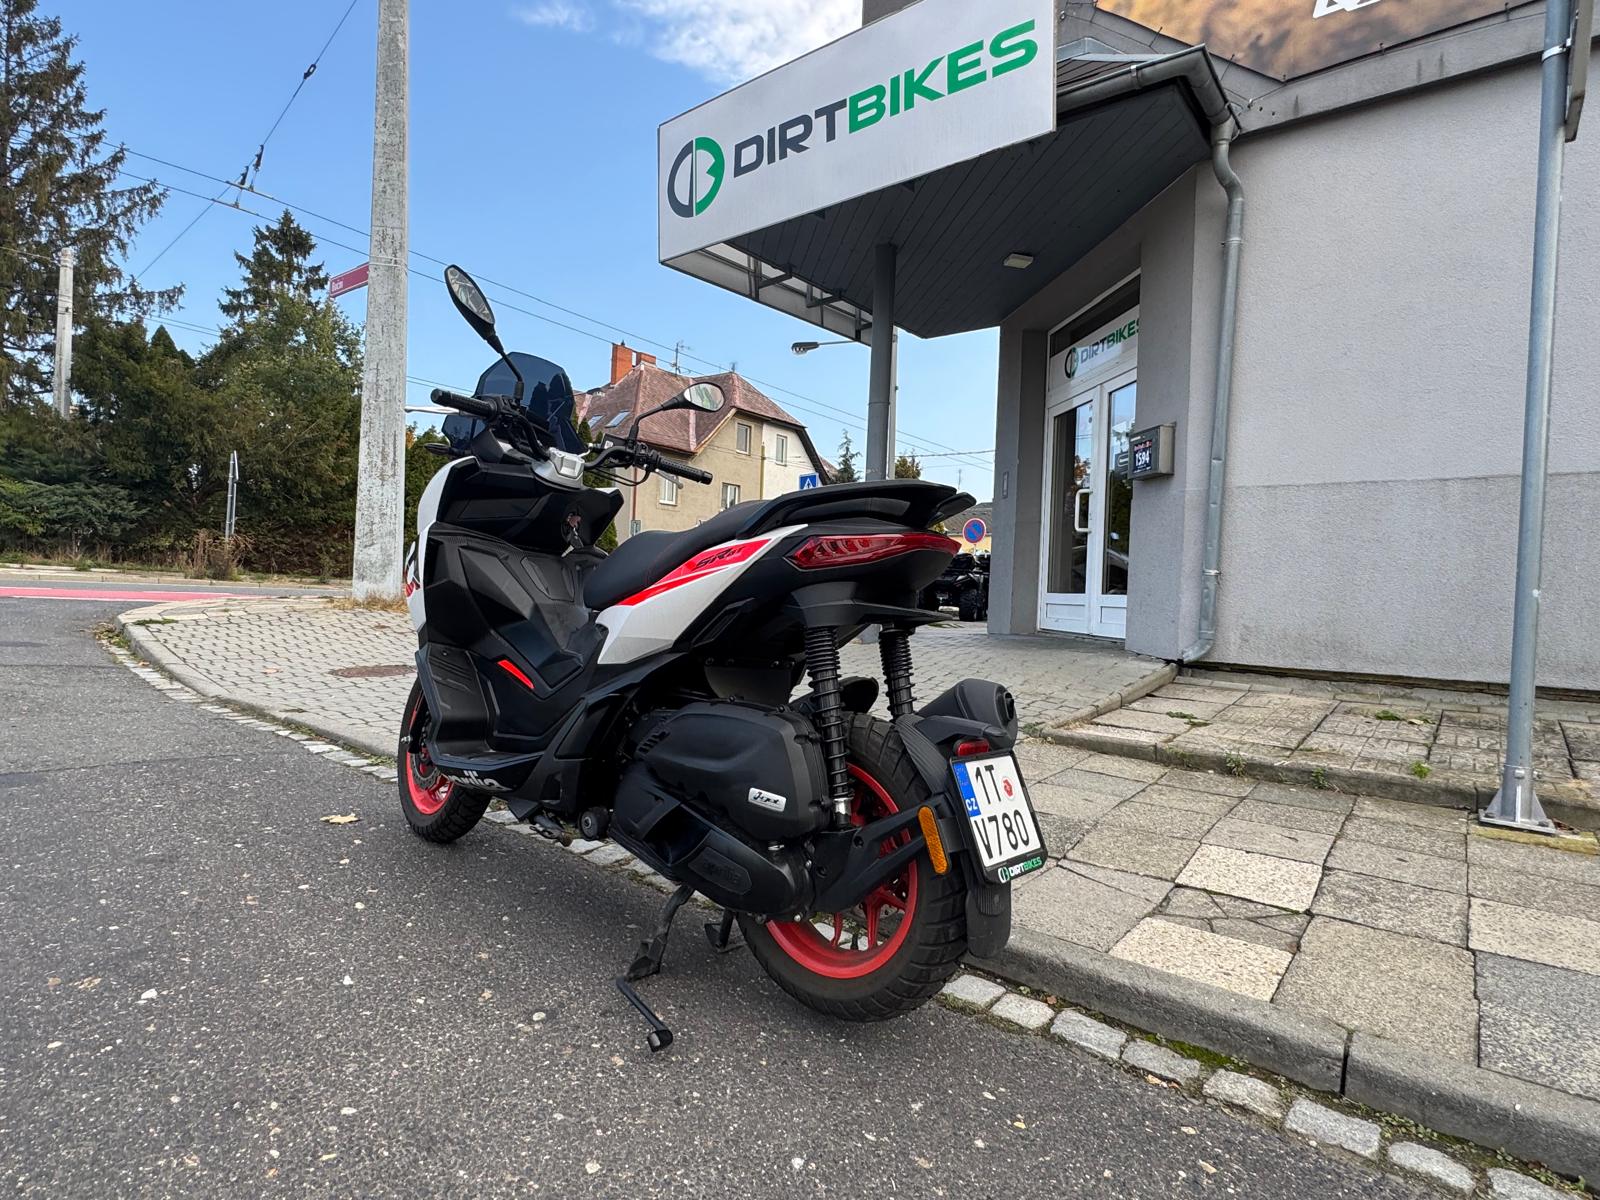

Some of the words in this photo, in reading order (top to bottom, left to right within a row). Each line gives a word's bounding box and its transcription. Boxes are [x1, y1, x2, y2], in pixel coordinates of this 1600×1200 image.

[733, 19, 1039, 179] DIRTBIKES
[965, 797, 978, 812] CZ
[975, 764, 1002, 805] 1T
[973, 809, 1030, 860] V780
[1008, 856, 1042, 876] DIRTBIKES
